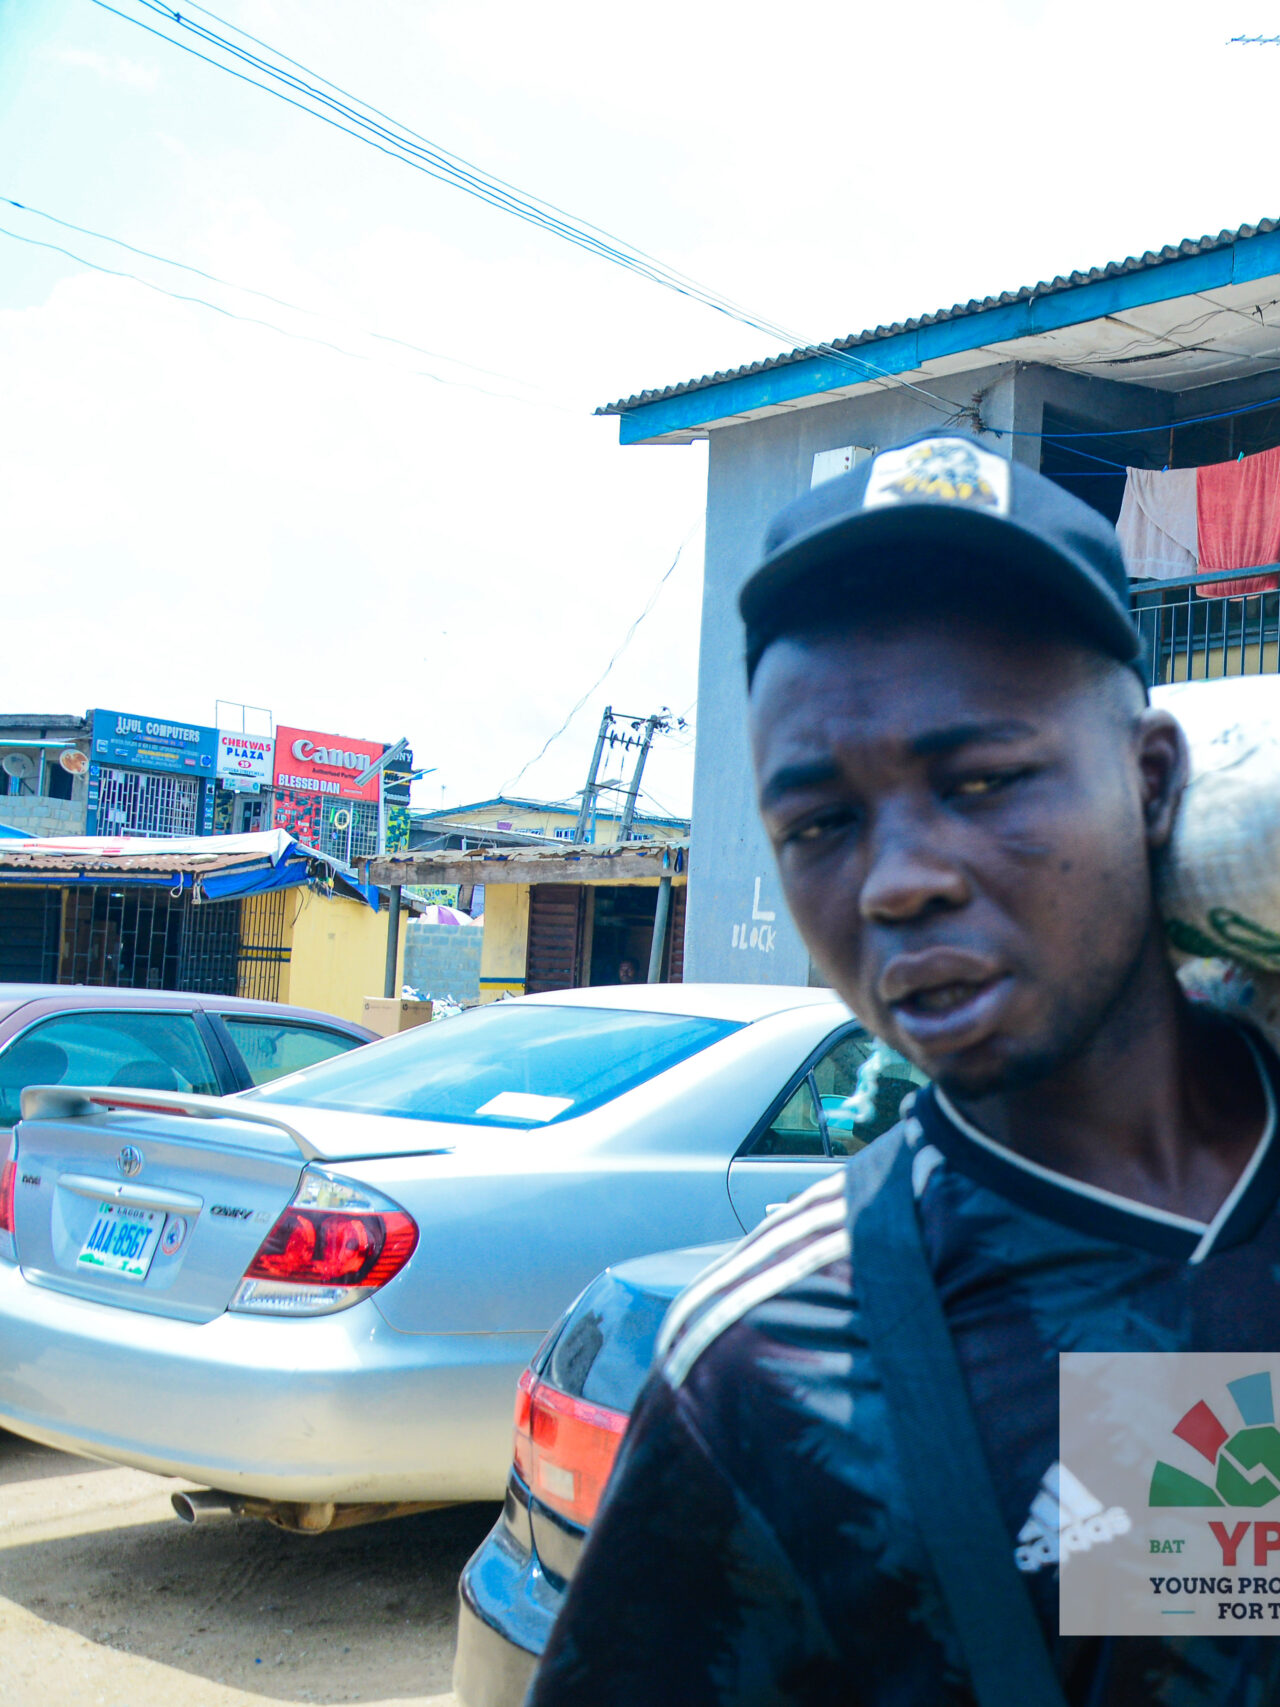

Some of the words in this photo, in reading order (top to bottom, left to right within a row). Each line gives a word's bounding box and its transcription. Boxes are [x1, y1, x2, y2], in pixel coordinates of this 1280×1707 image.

[145, 722, 201, 743] COMPUTERS
[222, 736, 272, 752] CHEKWAS
[226, 747, 264, 760] PLAZA
[291, 739, 370, 771] Canon
[278, 774, 320, 791] BLESSED
[321, 780, 341, 794] DAN
[732, 923, 776, 952] BLOCK
